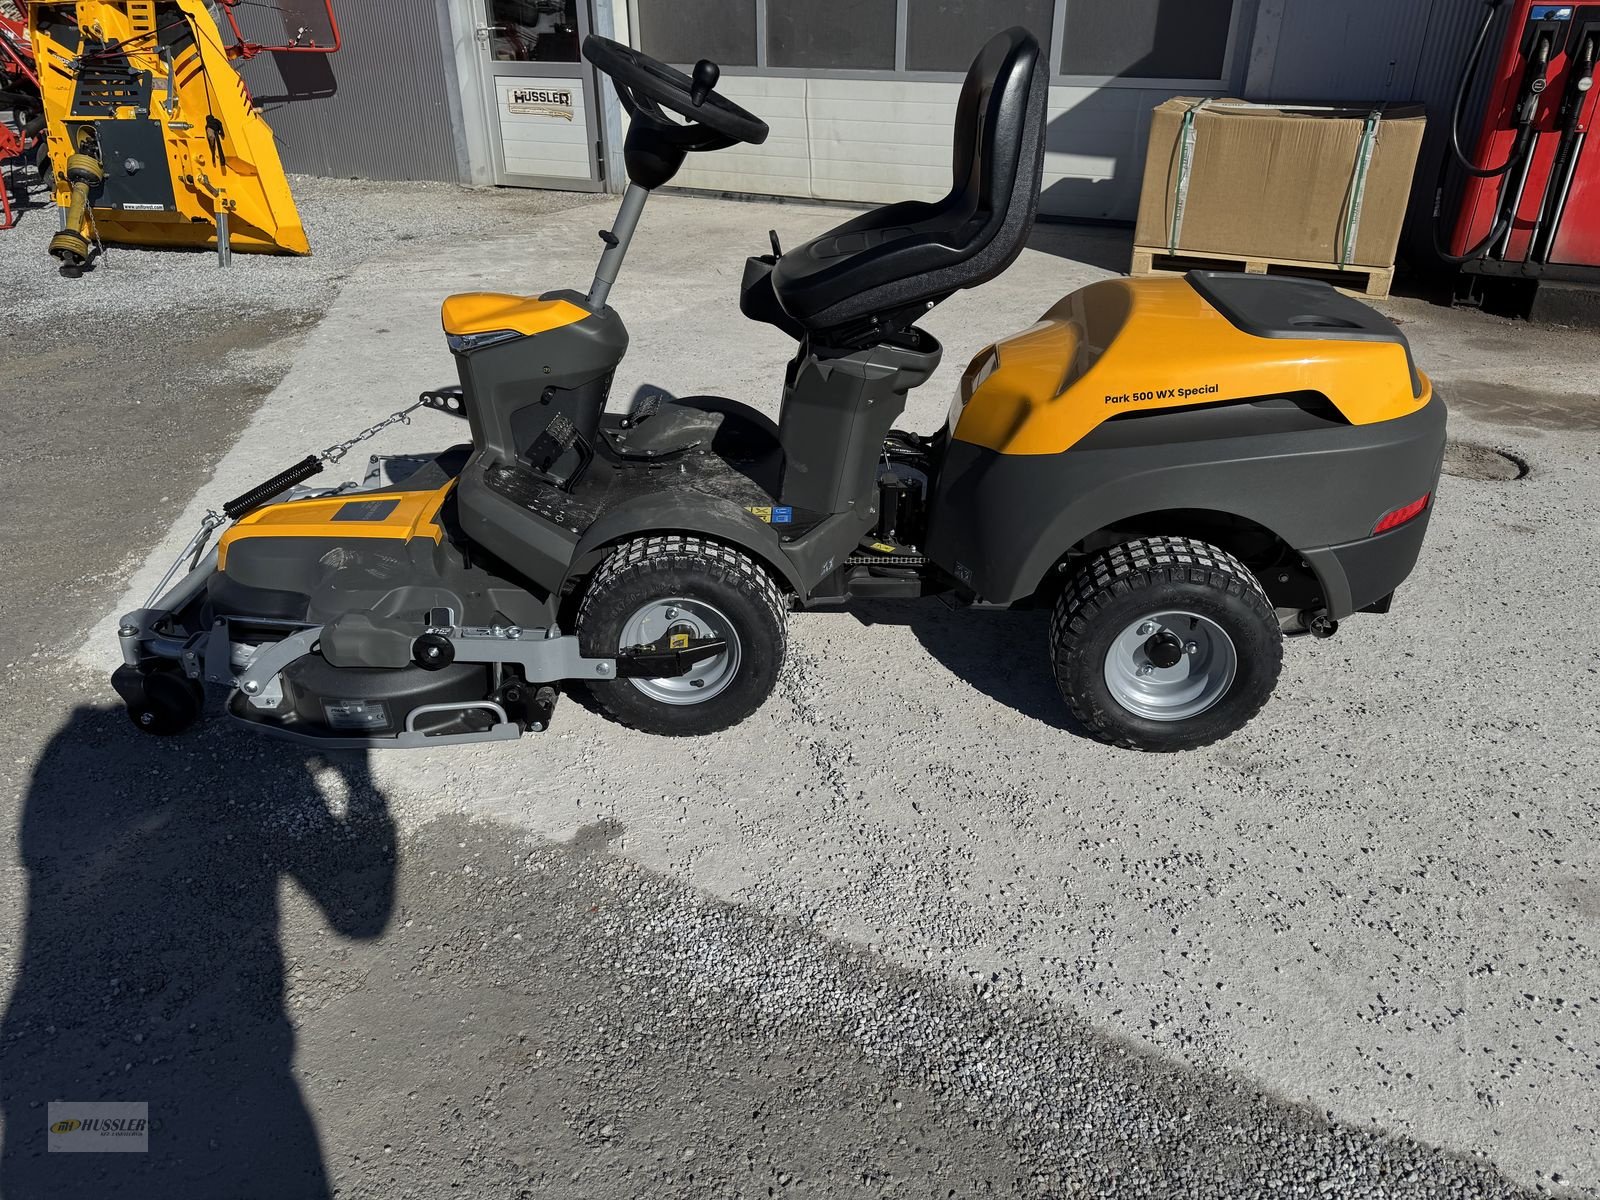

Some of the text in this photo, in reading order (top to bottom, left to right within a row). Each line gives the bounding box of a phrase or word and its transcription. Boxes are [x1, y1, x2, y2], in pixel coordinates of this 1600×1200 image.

[1104, 383, 1219, 404] Park 500 WX Special
